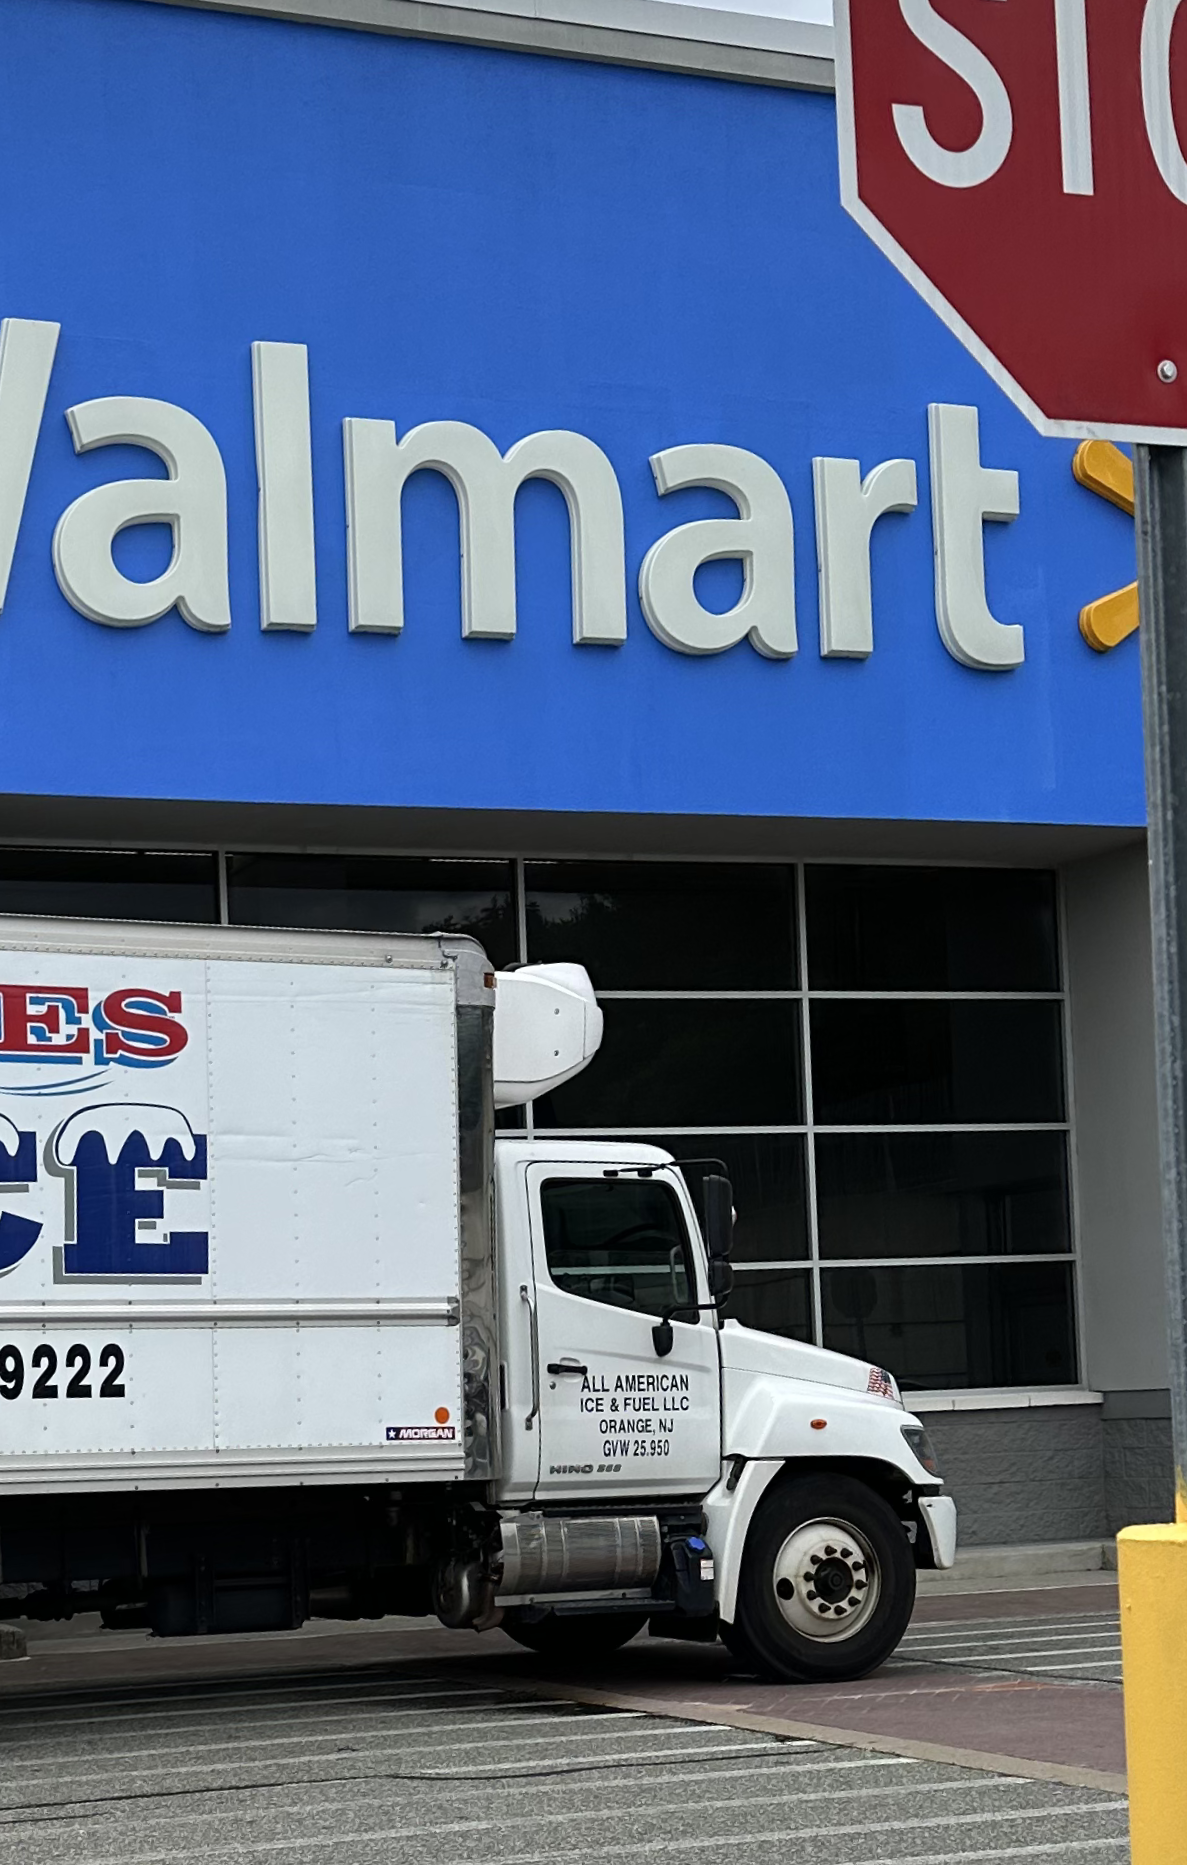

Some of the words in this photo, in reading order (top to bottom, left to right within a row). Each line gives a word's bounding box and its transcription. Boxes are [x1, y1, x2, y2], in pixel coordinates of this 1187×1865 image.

[580, 1375, 610, 1393] ALL
[614, 1374, 689, 1393] AMERICAN
[580, 1397, 604, 1413] ICE
[610, 1398, 620, 1412] &
[623, 1397, 660, 1412] FUEL
[663, 1396, 690, 1412] LLC
[398, 1428, 453, 1439] MORGAN
[599, 1418, 656, 1436] ORANGE,
[659, 1418, 674, 1433] NJ
[603, 1439, 630, 1457] GVW
[549, 1464, 594, 1475] HINO
